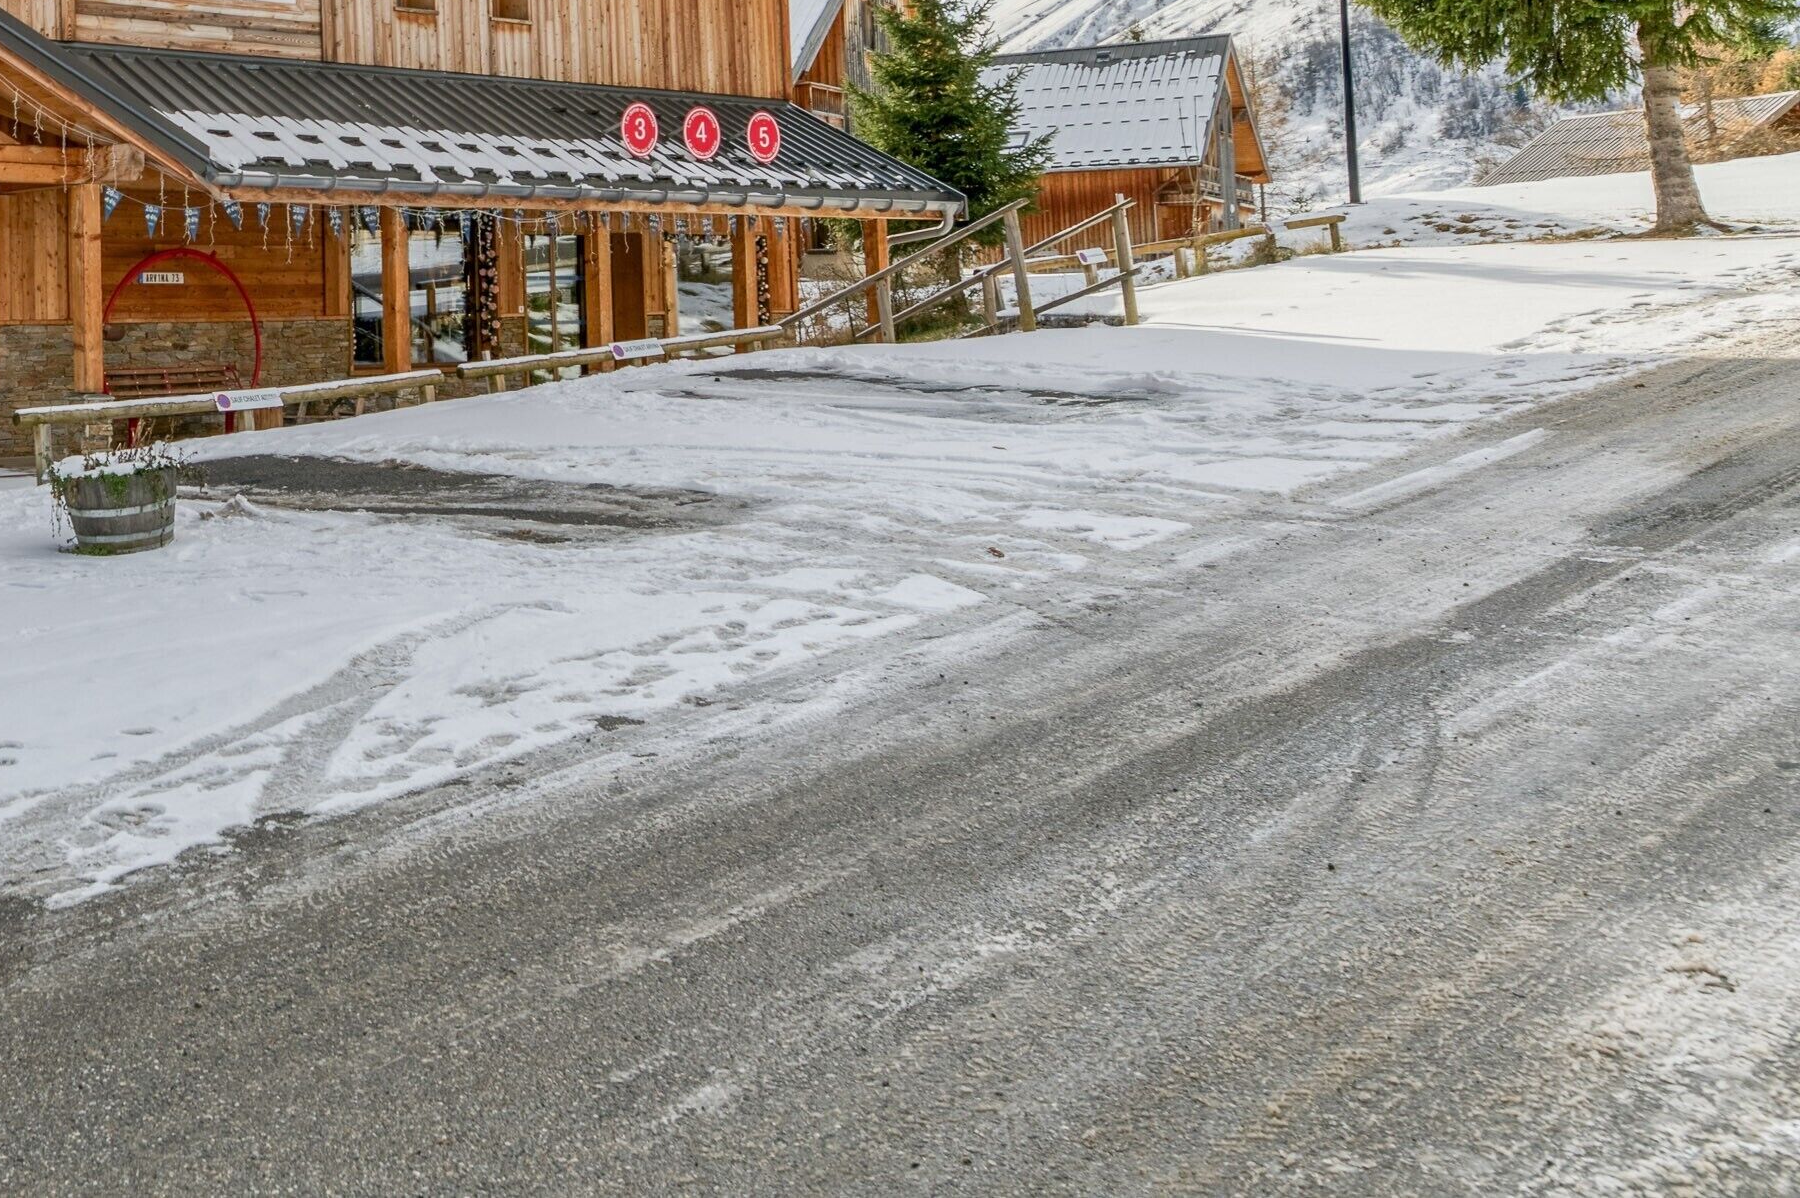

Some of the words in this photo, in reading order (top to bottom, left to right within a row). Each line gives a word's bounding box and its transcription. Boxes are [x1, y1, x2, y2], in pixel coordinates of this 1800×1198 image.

[634, 117, 646, 140] 3
[695, 121, 708, 143] 4
[759, 126, 770, 148] 5
[172, 273, 180, 283] 73
